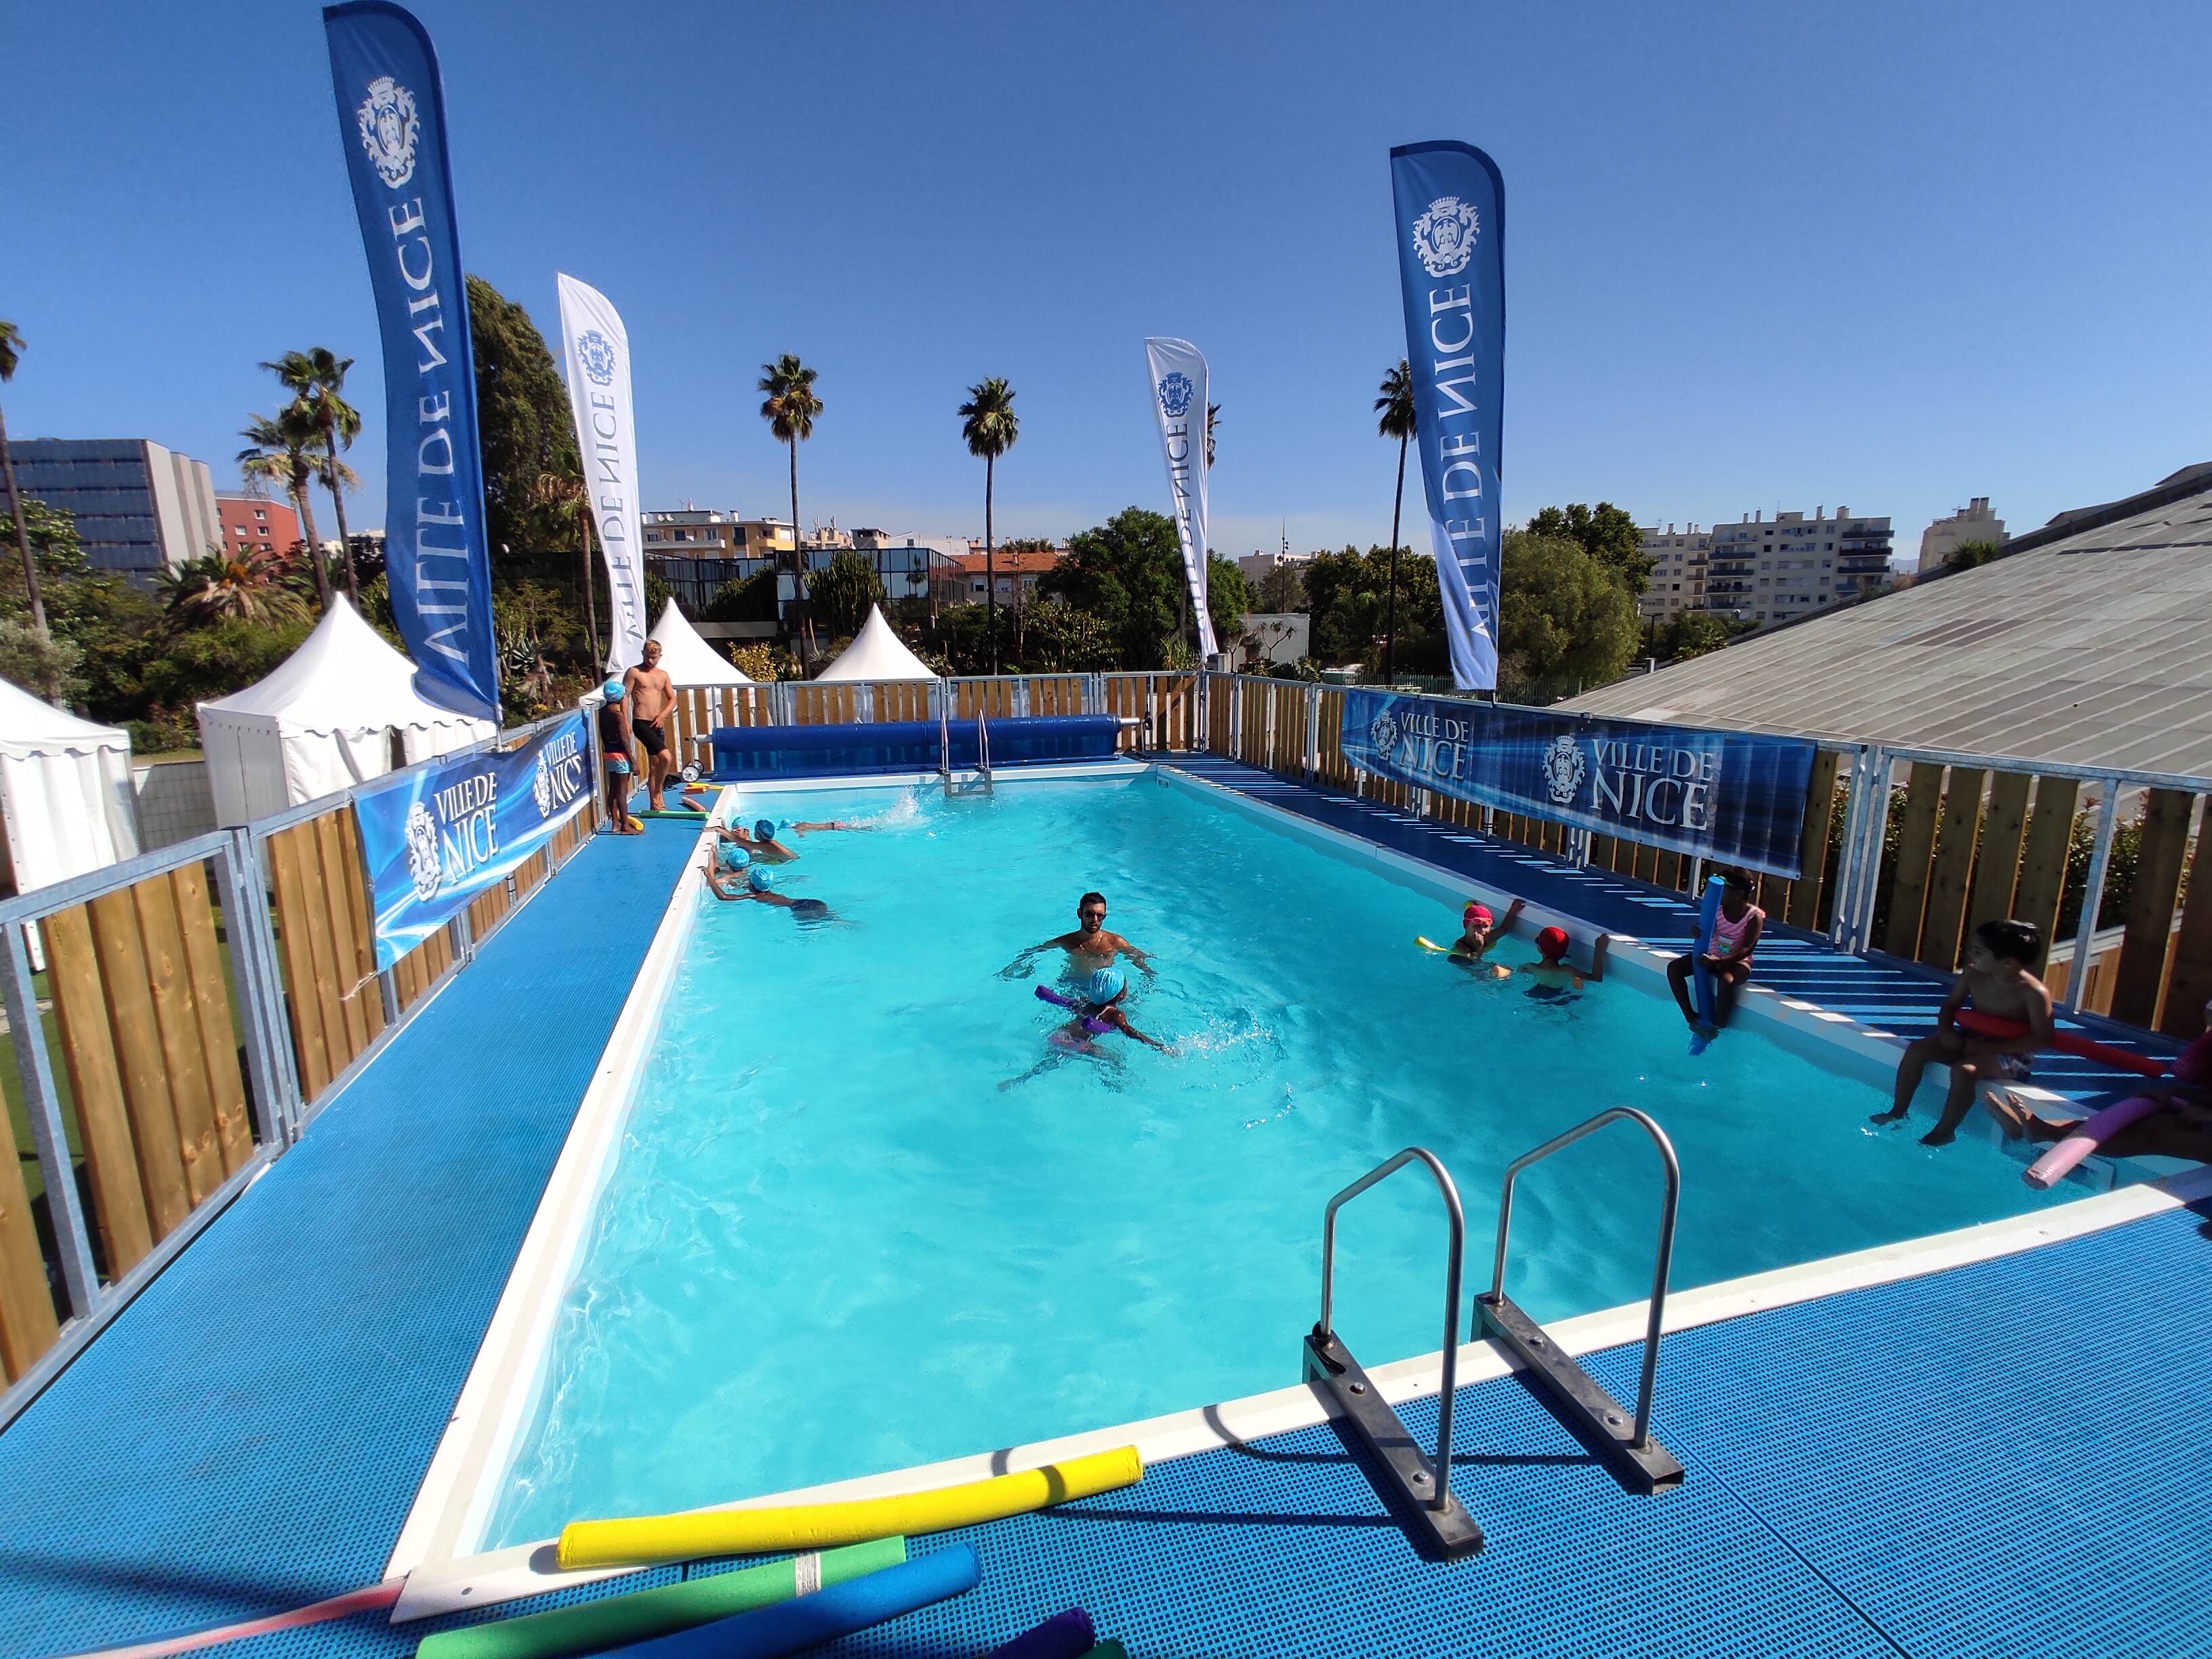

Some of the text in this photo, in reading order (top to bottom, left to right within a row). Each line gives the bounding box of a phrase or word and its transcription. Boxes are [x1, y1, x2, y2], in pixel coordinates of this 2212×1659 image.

[545, 732, 577, 767] VILLE DE
[1401, 712, 1469, 742] VILLE DE
[1399, 733, 1467, 779] NICE
[1591, 739, 1715, 781] VILLE DE
[433, 772, 497, 825] VILLE DE
[1590, 766, 1708, 831] NICE
[443, 804, 499, 884] NICE
